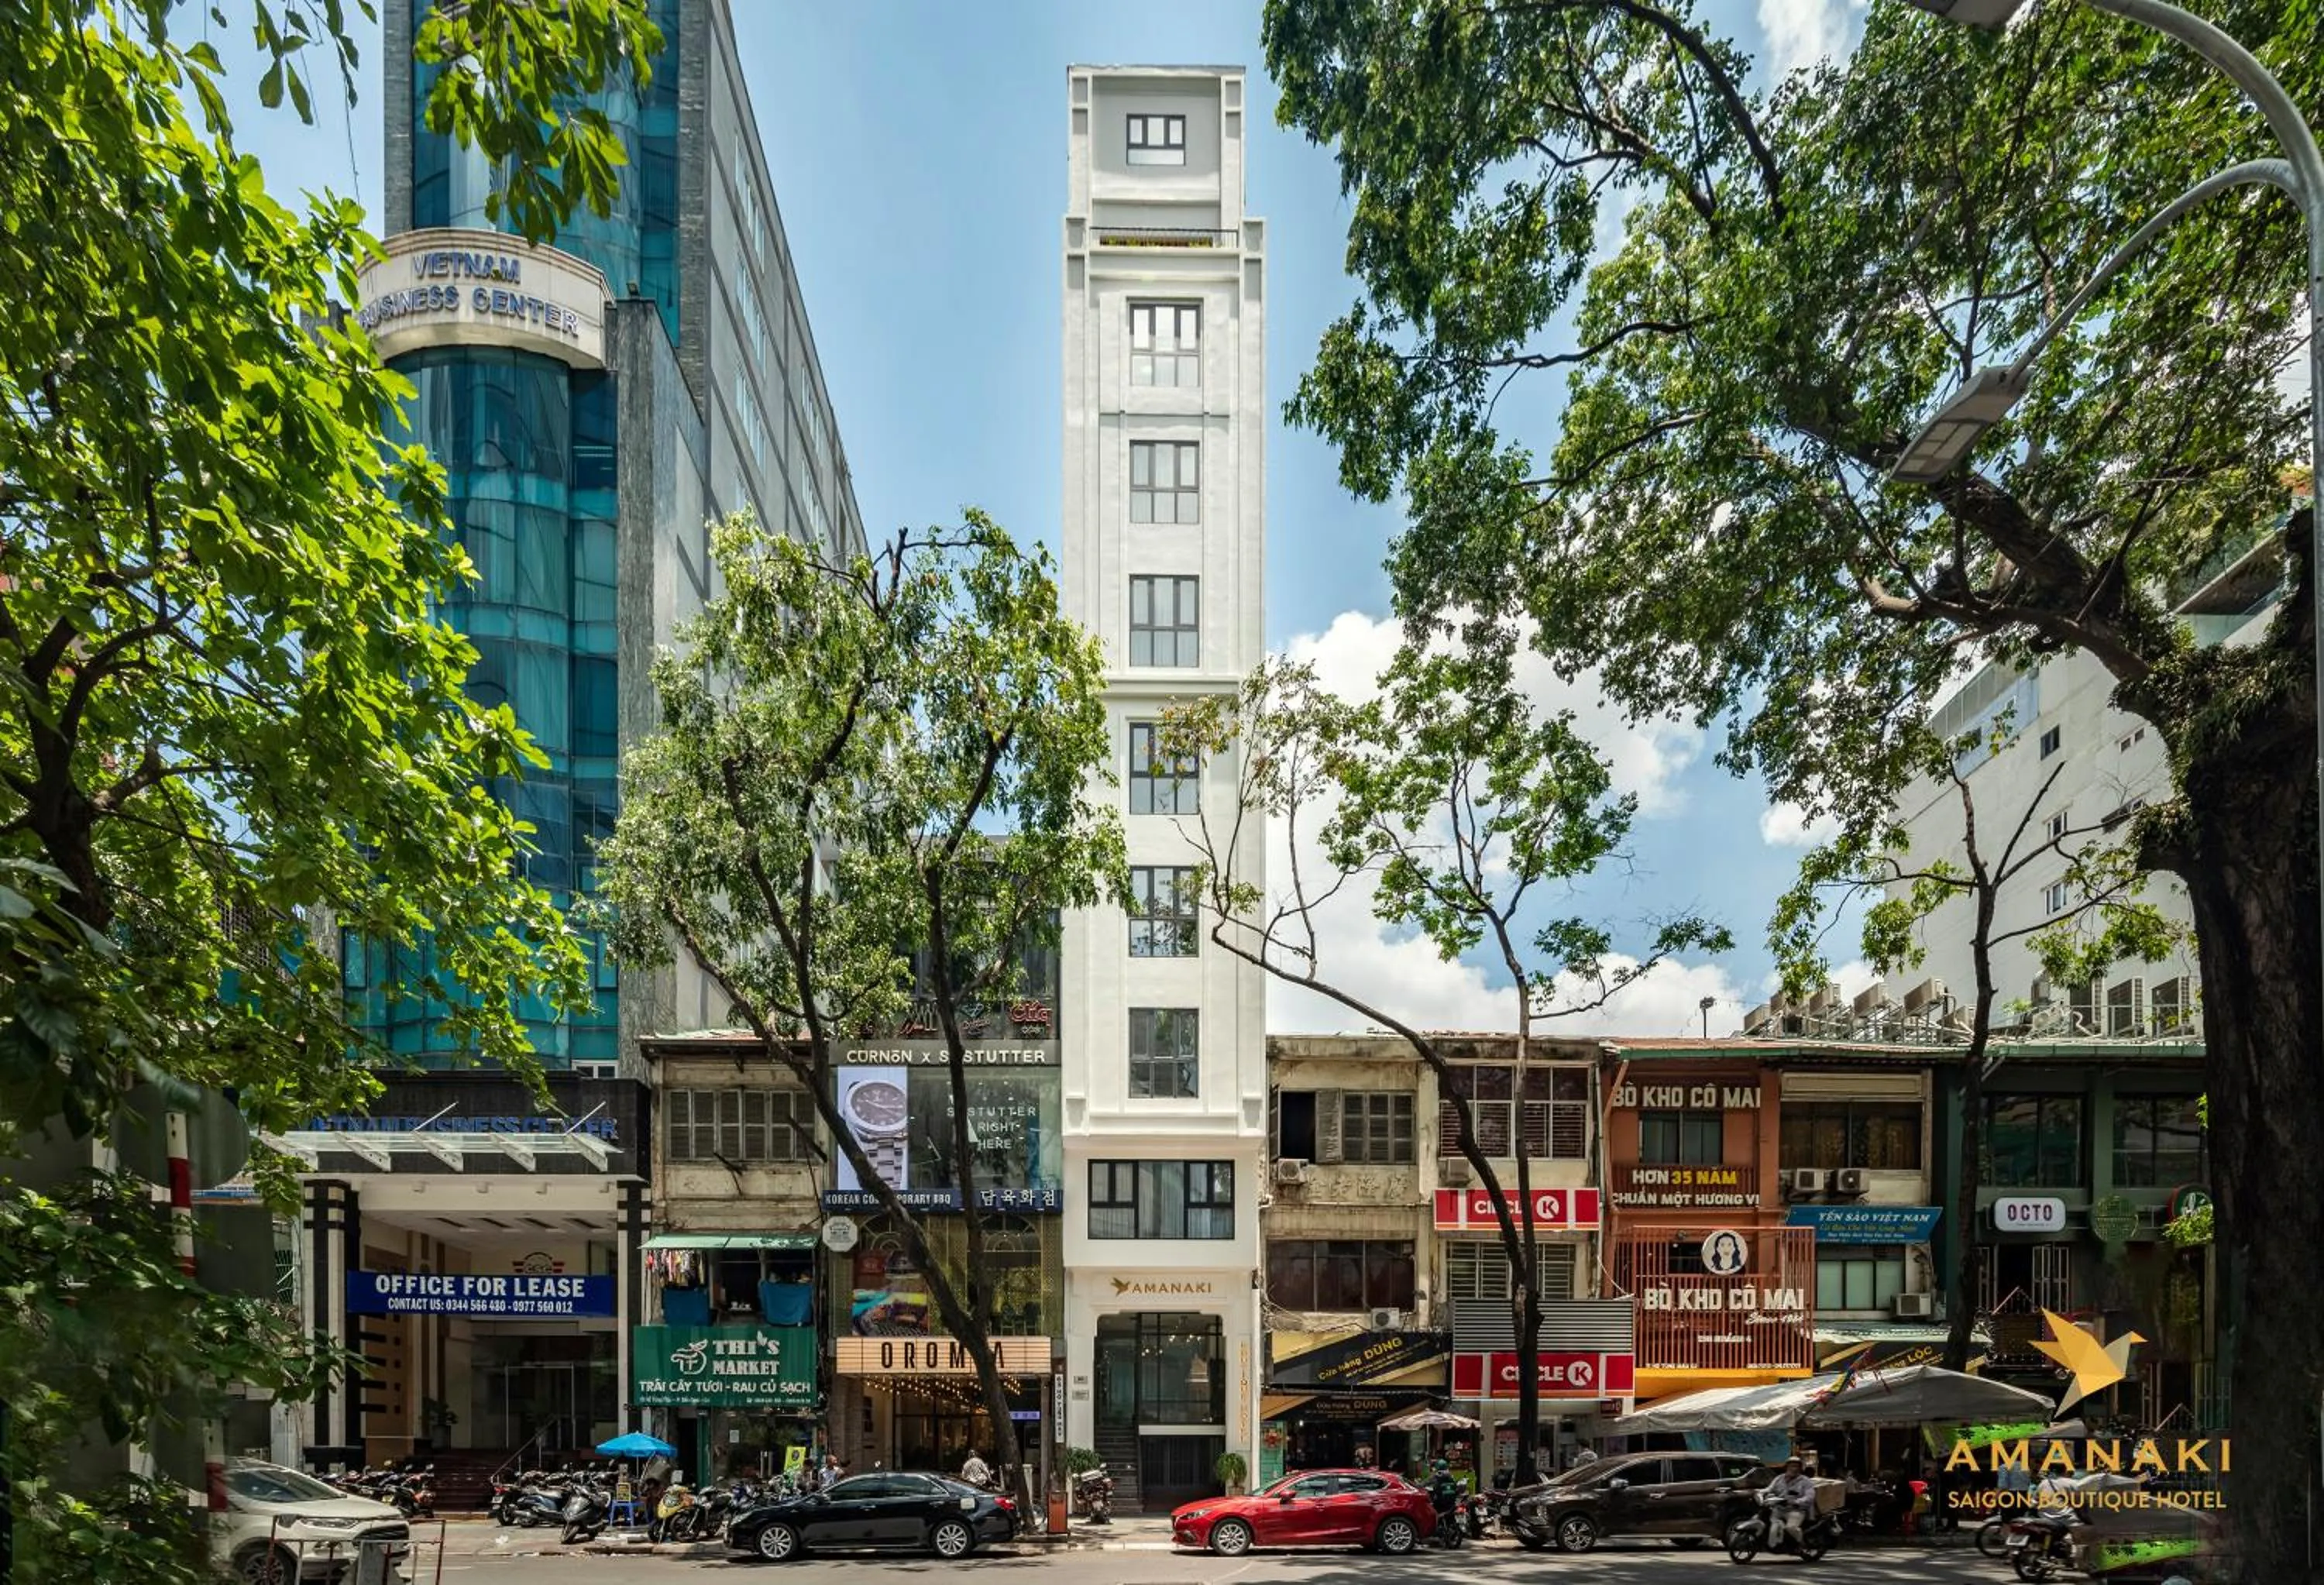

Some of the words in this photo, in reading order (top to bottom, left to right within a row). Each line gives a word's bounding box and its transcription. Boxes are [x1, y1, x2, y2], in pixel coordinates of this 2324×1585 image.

[413, 252, 521, 285] VIETNAM
[473, 287, 579, 338] CENTER
[939, 1049, 1046, 1064] SSTUTTER
[1642, 1086, 1684, 1108] KHO
[1690, 1082, 1717, 1109] CÔ
[1722, 1087, 1762, 1109] MAI
[946, 1106, 1037, 1117] SSTUTTER
[976, 1121, 1016, 1133] RIGHT
[978, 1138, 1012, 1150] HERE
[1671, 1170, 1693, 1184] 35
[2007, 1204, 2052, 1221] OCTO
[375, 1274, 456, 1295] OFFICE
[462, 1276, 507, 1296] FOR
[514, 1277, 585, 1298] LEASE
[1132, 1282, 1212, 1294] AMANAKI
[1644, 1281, 1671, 1310] BÒ
[1678, 1288, 1722, 1310] KHO
[1728, 1283, 1756, 1310] CÔ
[1763, 1288, 1804, 1310] MAI
[387, 1298, 428, 1311] CONTACT
[429, 1299, 445, 1311] US:
[446, 1300, 468, 1312] 0344
[555, 1301, 573, 1313] 012
[881, 1341, 1005, 1369] OROMA
[712, 1360, 780, 1375] MARKET
[732, 1381, 756, 1393] RAU
[780, 1381, 811, 1395] SẠCH
